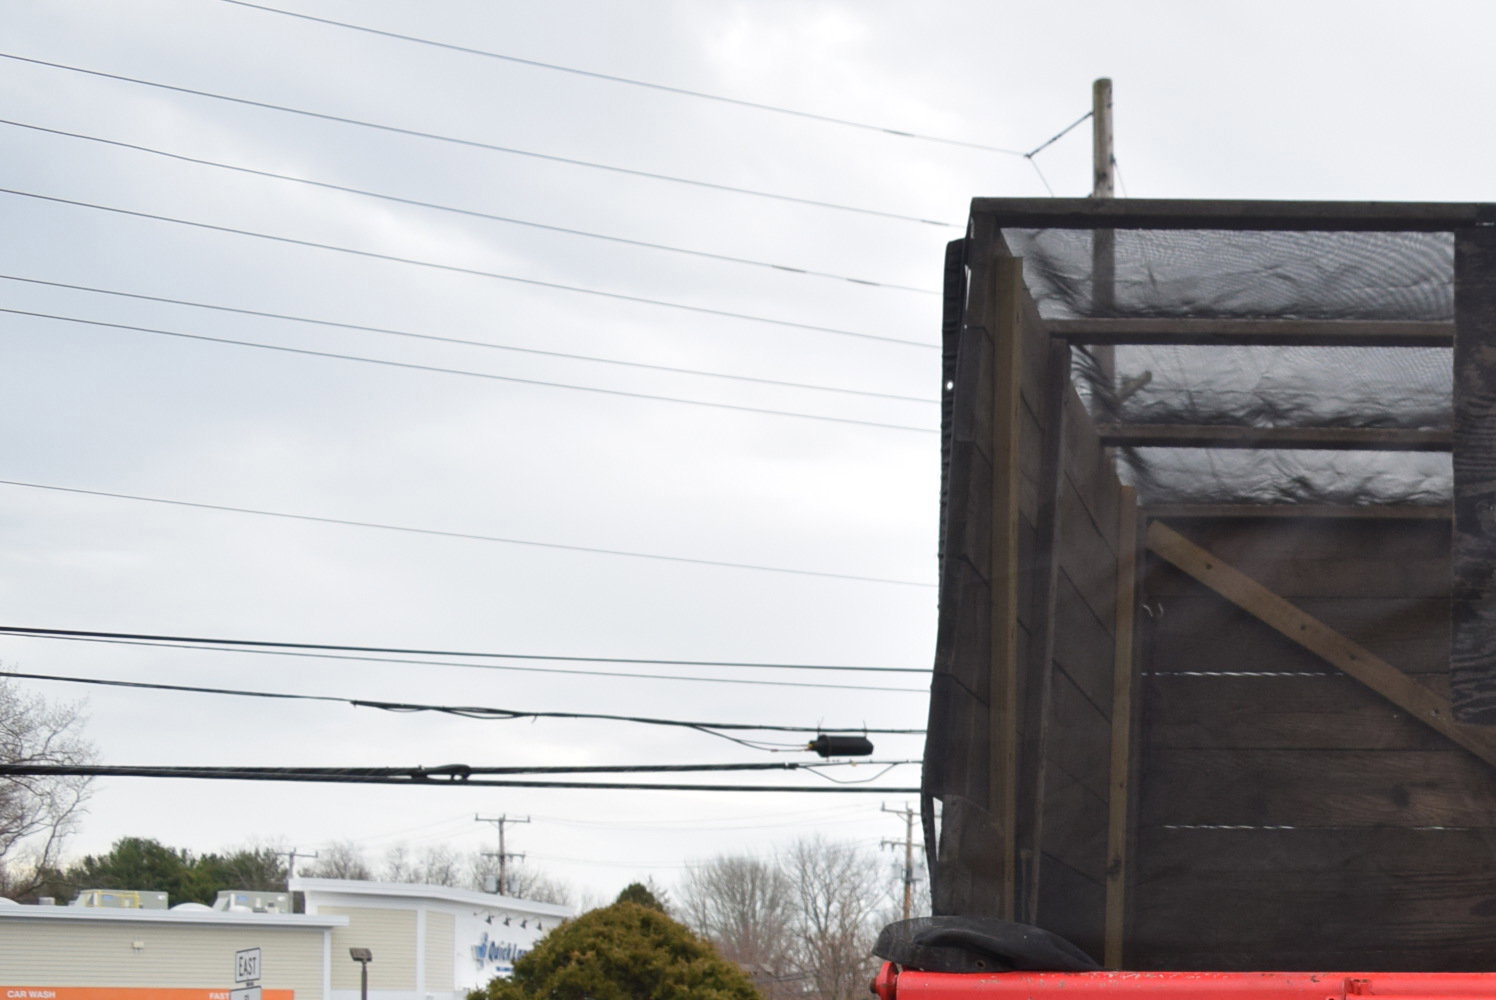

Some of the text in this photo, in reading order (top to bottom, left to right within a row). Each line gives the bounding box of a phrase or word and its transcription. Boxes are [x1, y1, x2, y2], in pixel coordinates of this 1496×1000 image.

[239, 956, 257, 977] EAST
[7, 990, 57, 999] CAR WASH
